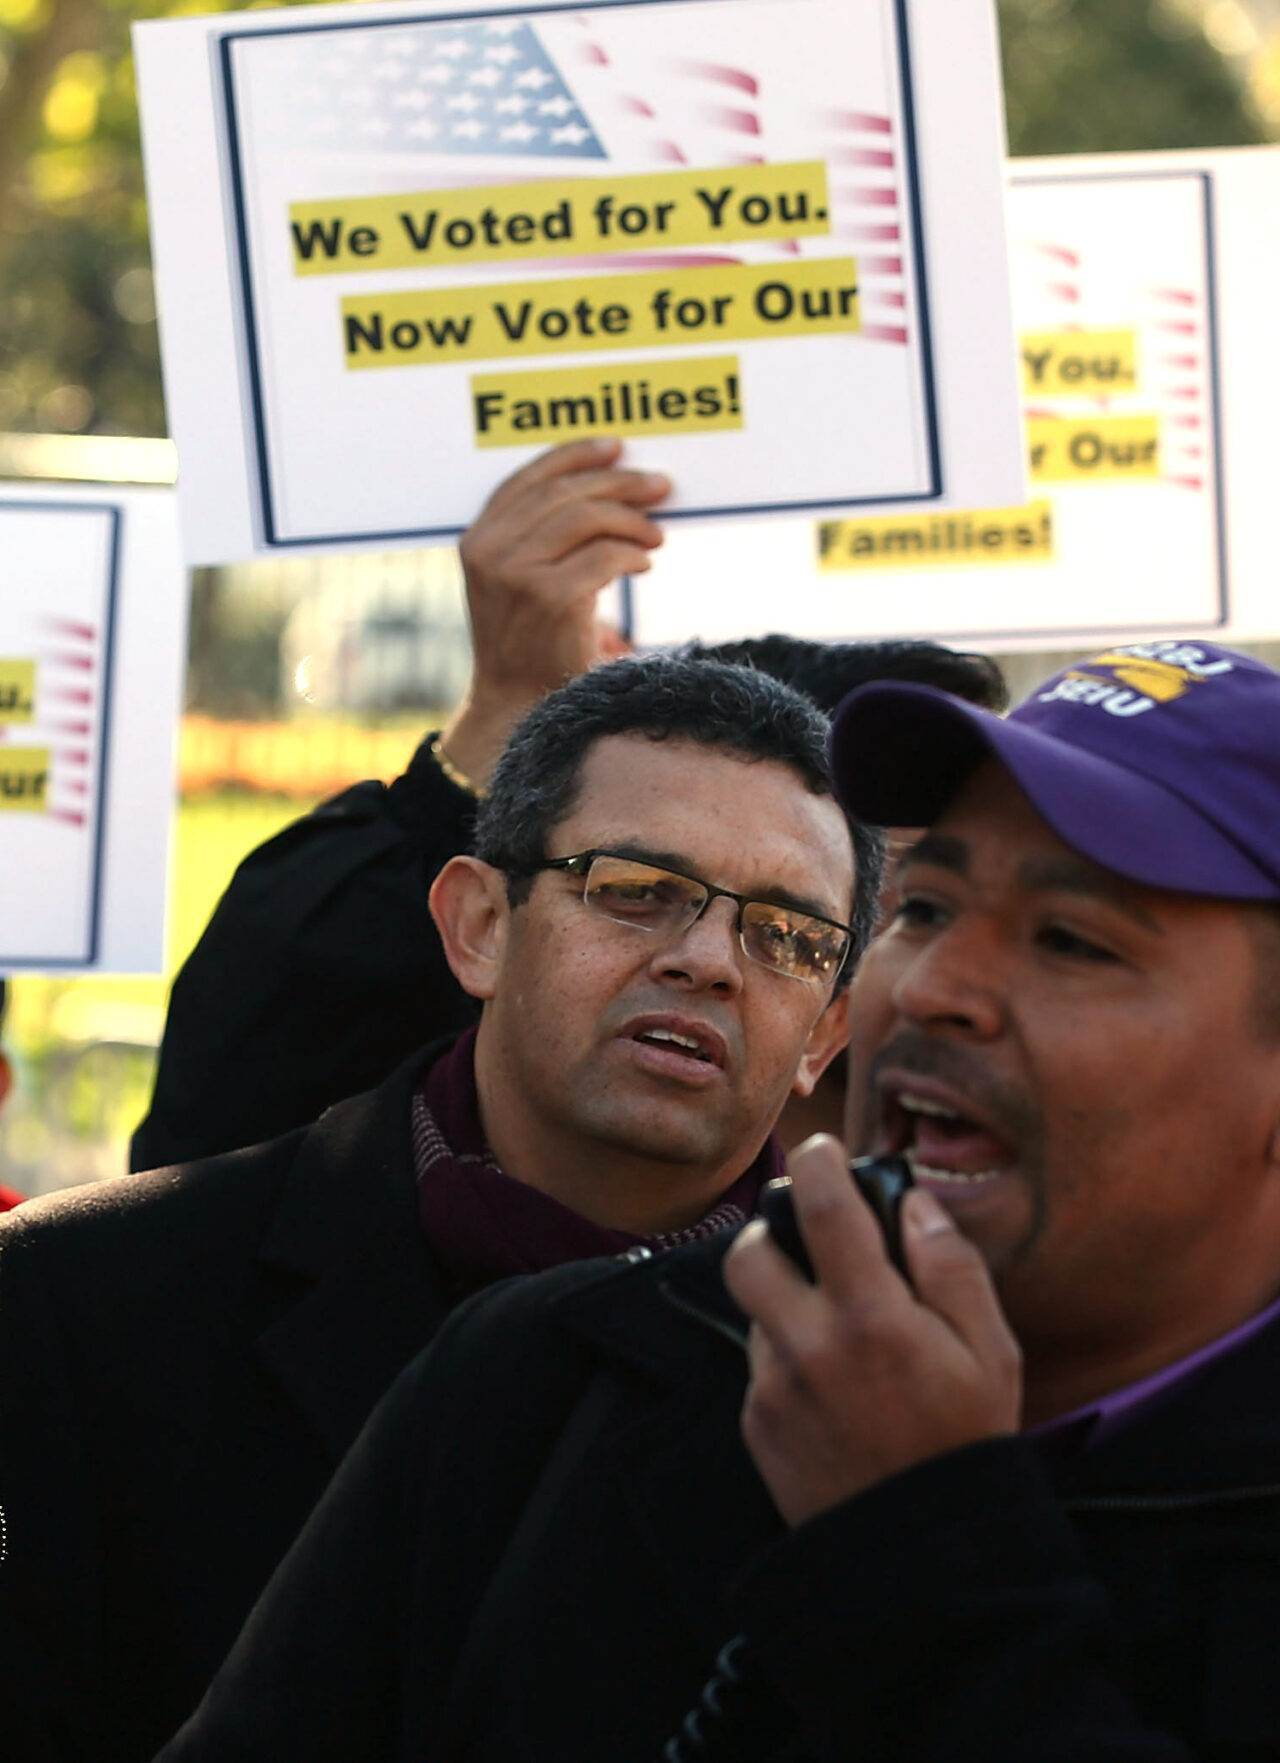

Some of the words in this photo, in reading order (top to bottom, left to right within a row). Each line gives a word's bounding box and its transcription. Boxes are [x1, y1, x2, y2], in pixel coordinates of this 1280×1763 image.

[291, 219, 379, 260] We
[400, 201, 572, 251] Voted
[594, 197, 675, 236] for
[697, 188, 827, 228] You.
[345, 314, 472, 354] Now
[494, 300, 630, 341] Vote
[652, 290, 732, 330] for
[755, 282, 857, 322] Our
[1021, 346, 1136, 384] You.
[475, 375, 739, 433] Families!
[1068, 430, 1158, 468] Our
[817, 512, 1052, 560] Families!
